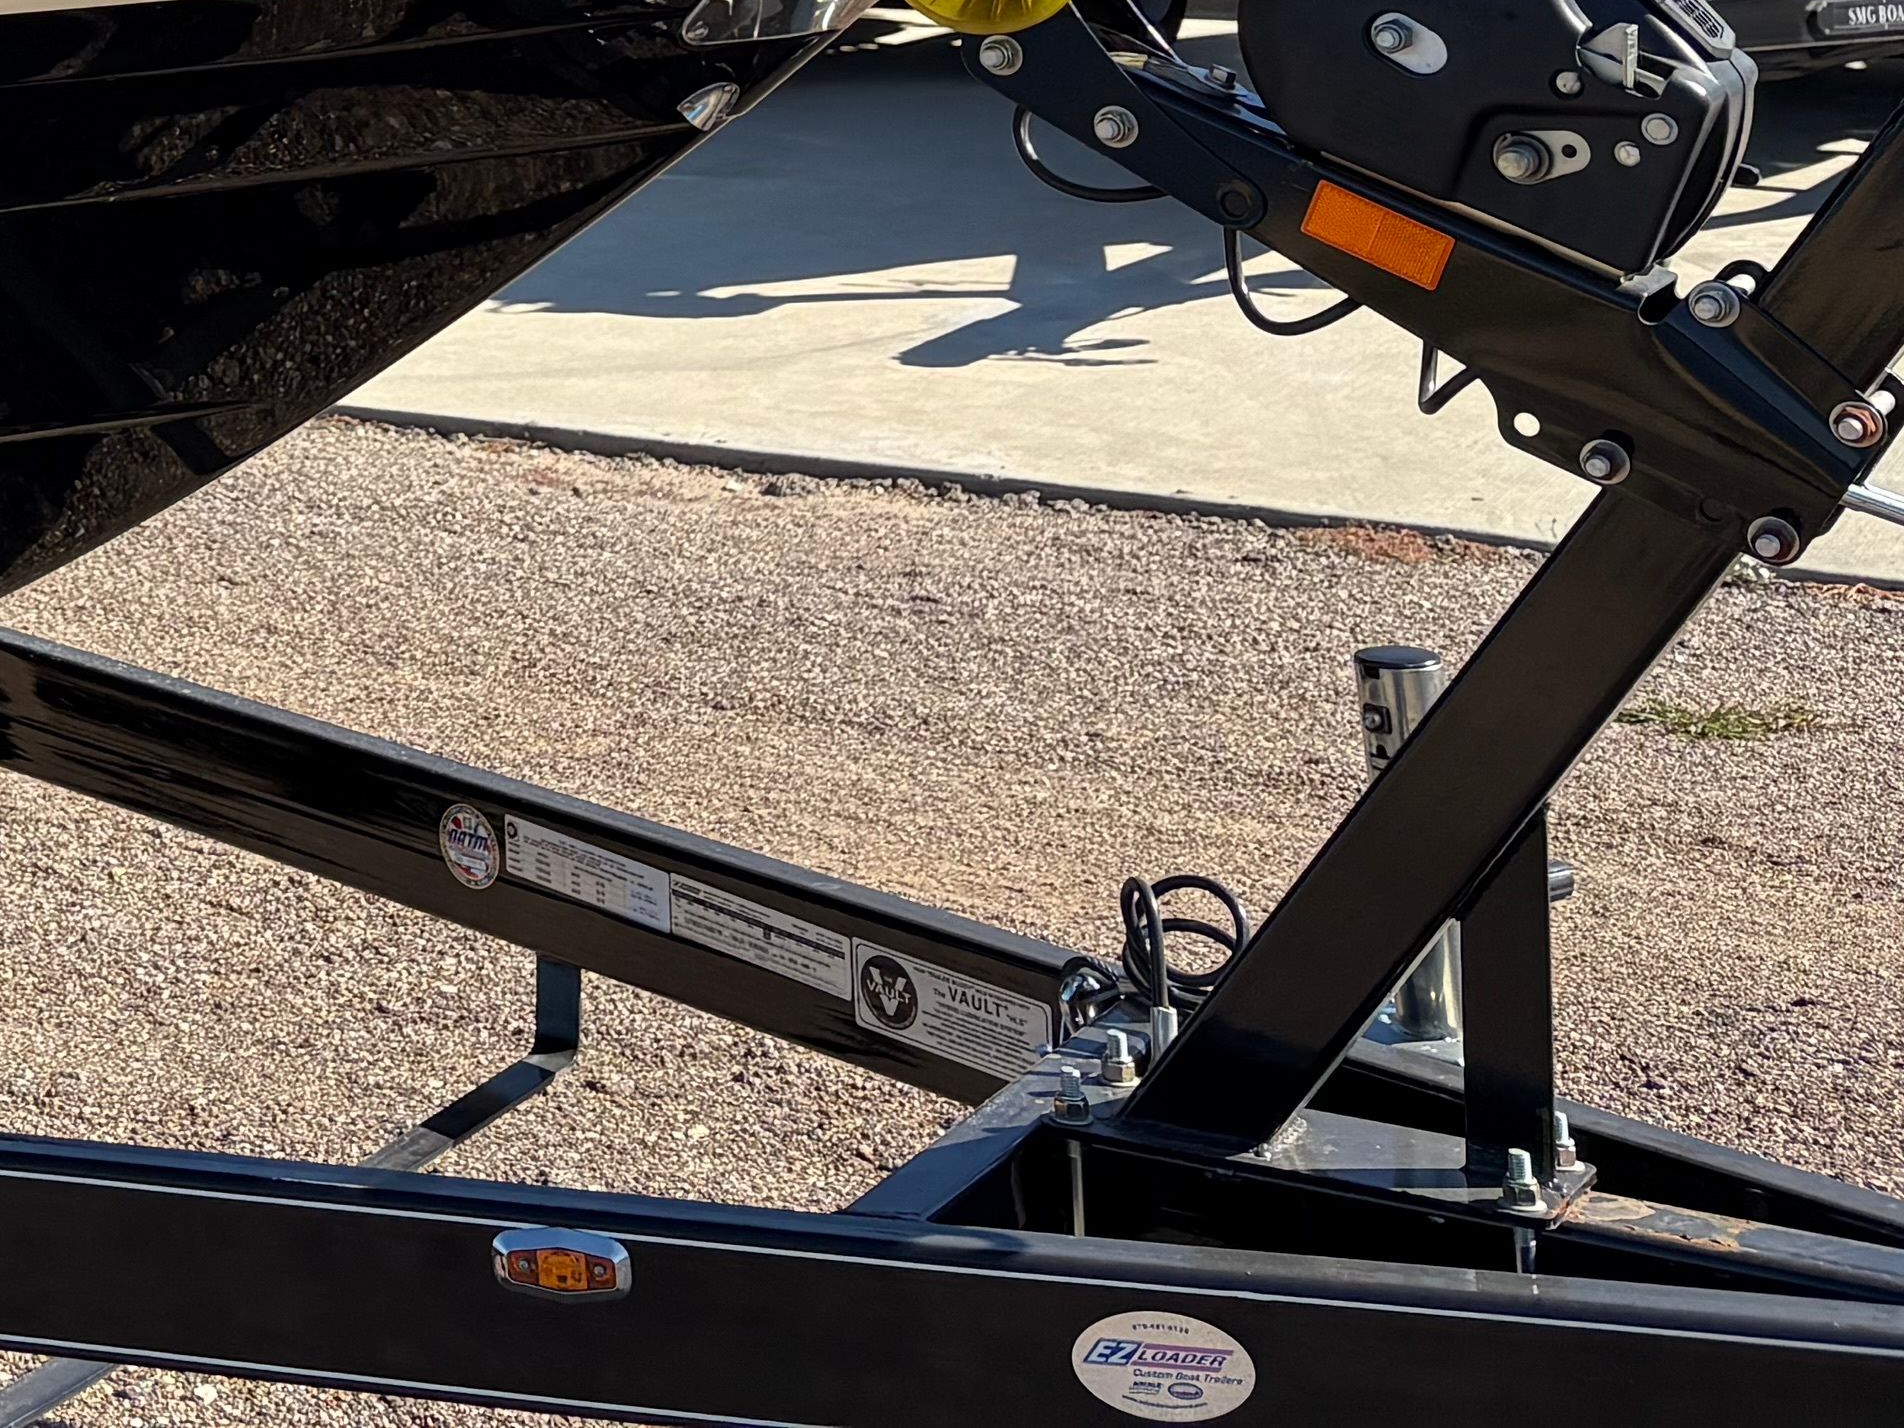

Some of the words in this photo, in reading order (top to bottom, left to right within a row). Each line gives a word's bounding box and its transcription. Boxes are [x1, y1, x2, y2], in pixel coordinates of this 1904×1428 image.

[1848, 6, 1876, 25] SMG
[867, 979, 912, 1004] VAULT
[948, 985, 1005, 1018] VAULT
[1088, 1341, 1139, 1364] EZ
[1137, 1349, 1227, 1367] LOADER
[1133, 1368, 1173, 1380] Custom
